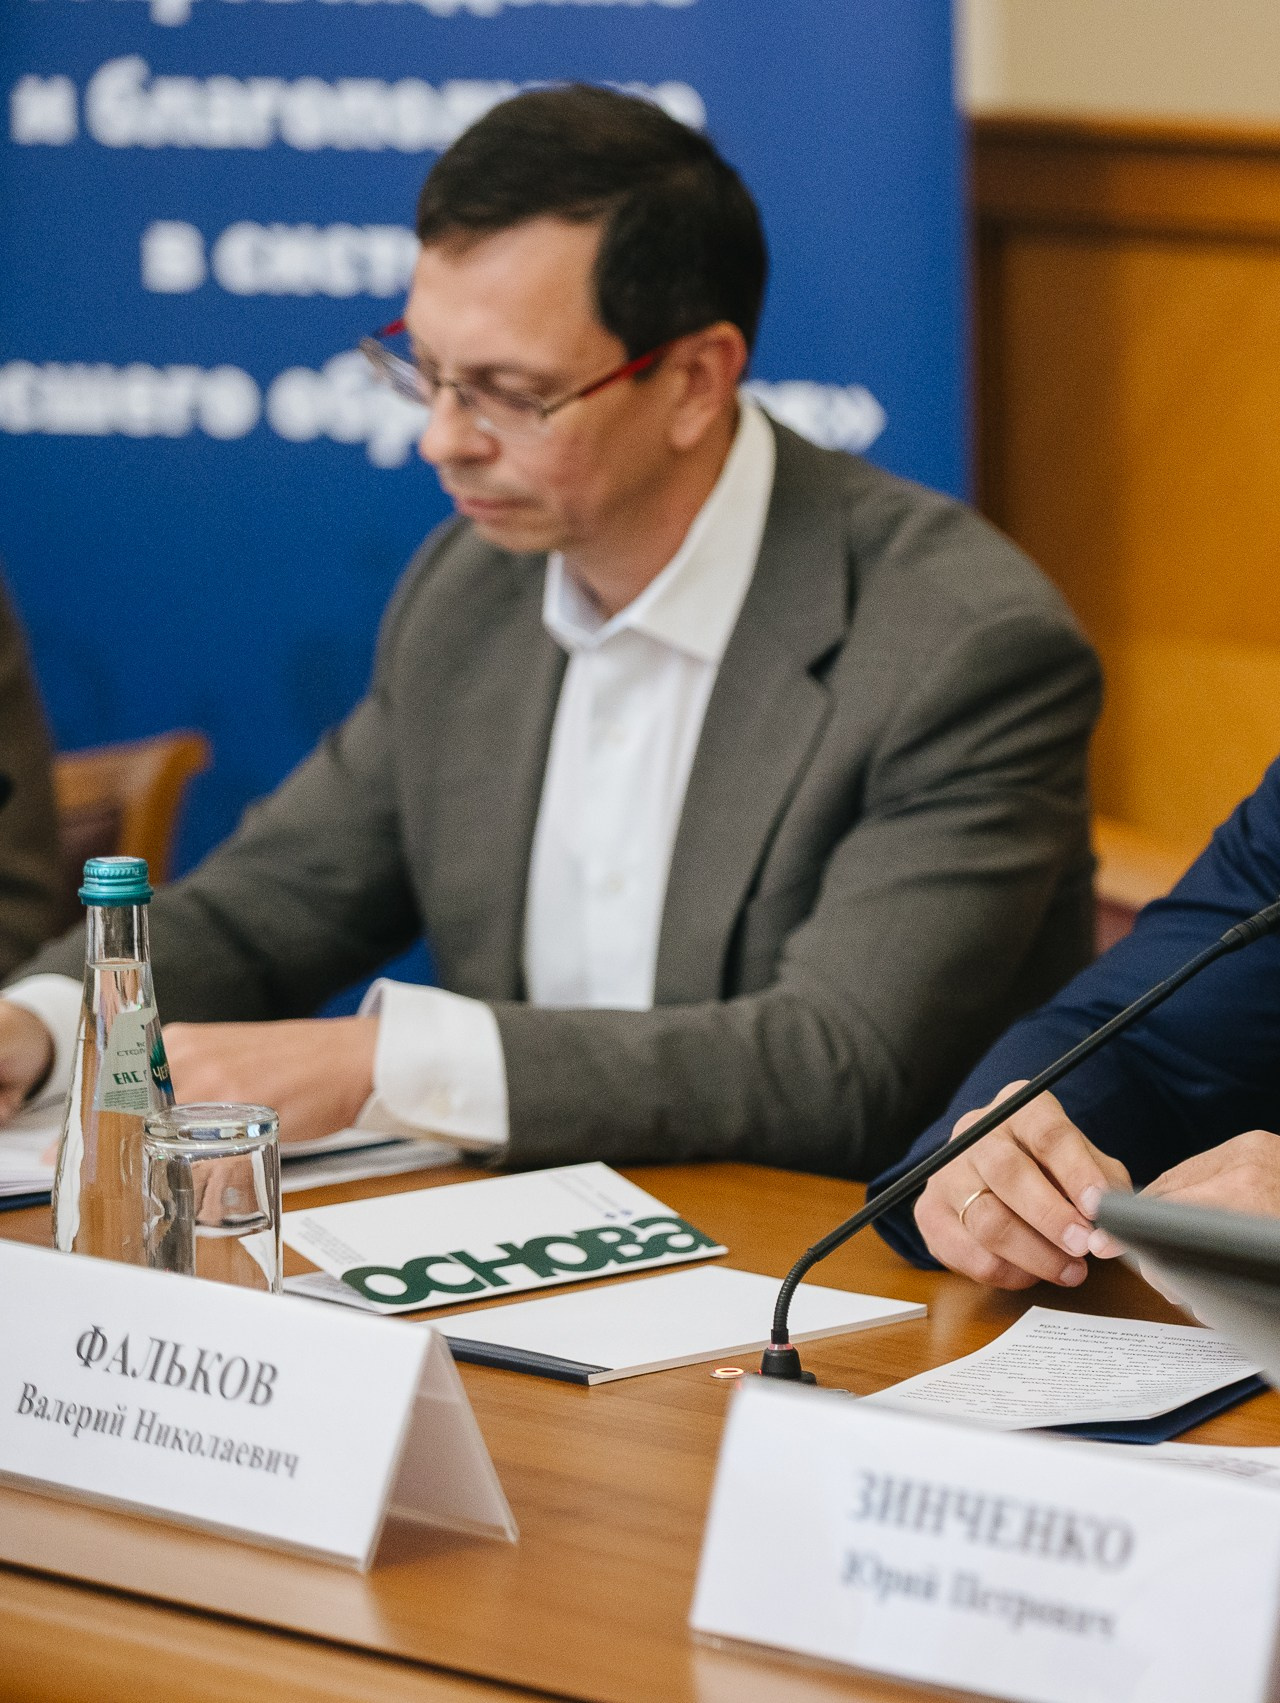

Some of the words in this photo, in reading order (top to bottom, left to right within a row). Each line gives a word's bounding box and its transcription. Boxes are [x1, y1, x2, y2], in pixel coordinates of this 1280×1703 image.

[86, 54, 706, 151] благопол
[212, 219, 418, 298] сист
[75, 1324, 279, 1407] ФАЛЬКОВ
[16, 1382, 128, 1438] Валерий
[132, 1407, 300, 1479] Николаевич
[849, 1468, 1137, 1573] ЗИНЧЕНКО
[841, 1547, 942, 1606] Юрий
